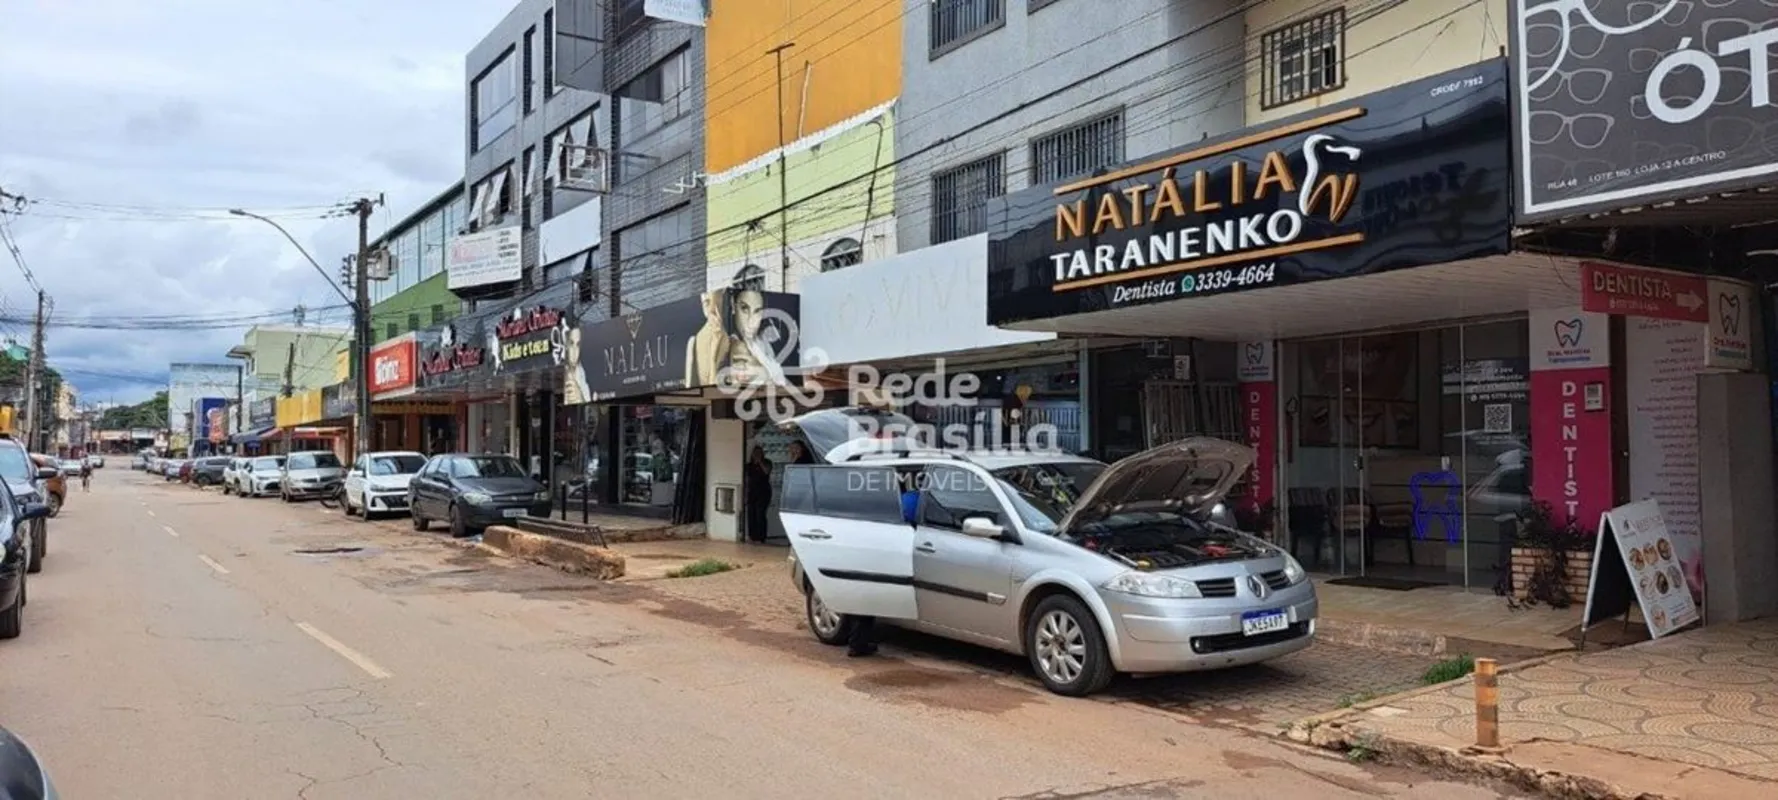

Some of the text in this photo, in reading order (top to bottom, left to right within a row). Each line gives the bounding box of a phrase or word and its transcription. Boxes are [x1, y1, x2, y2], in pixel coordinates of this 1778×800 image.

[1682, 150, 1726, 166] CENTRO
[1056, 150, 1297, 241] NATÁLIA
[1049, 208, 1303, 281] TARANENKO
[1113, 262, 1276, 303] Dentista 3339-4664
[1593, 266, 1672, 299] DENTISTA
[603, 334, 669, 376] NALAU
